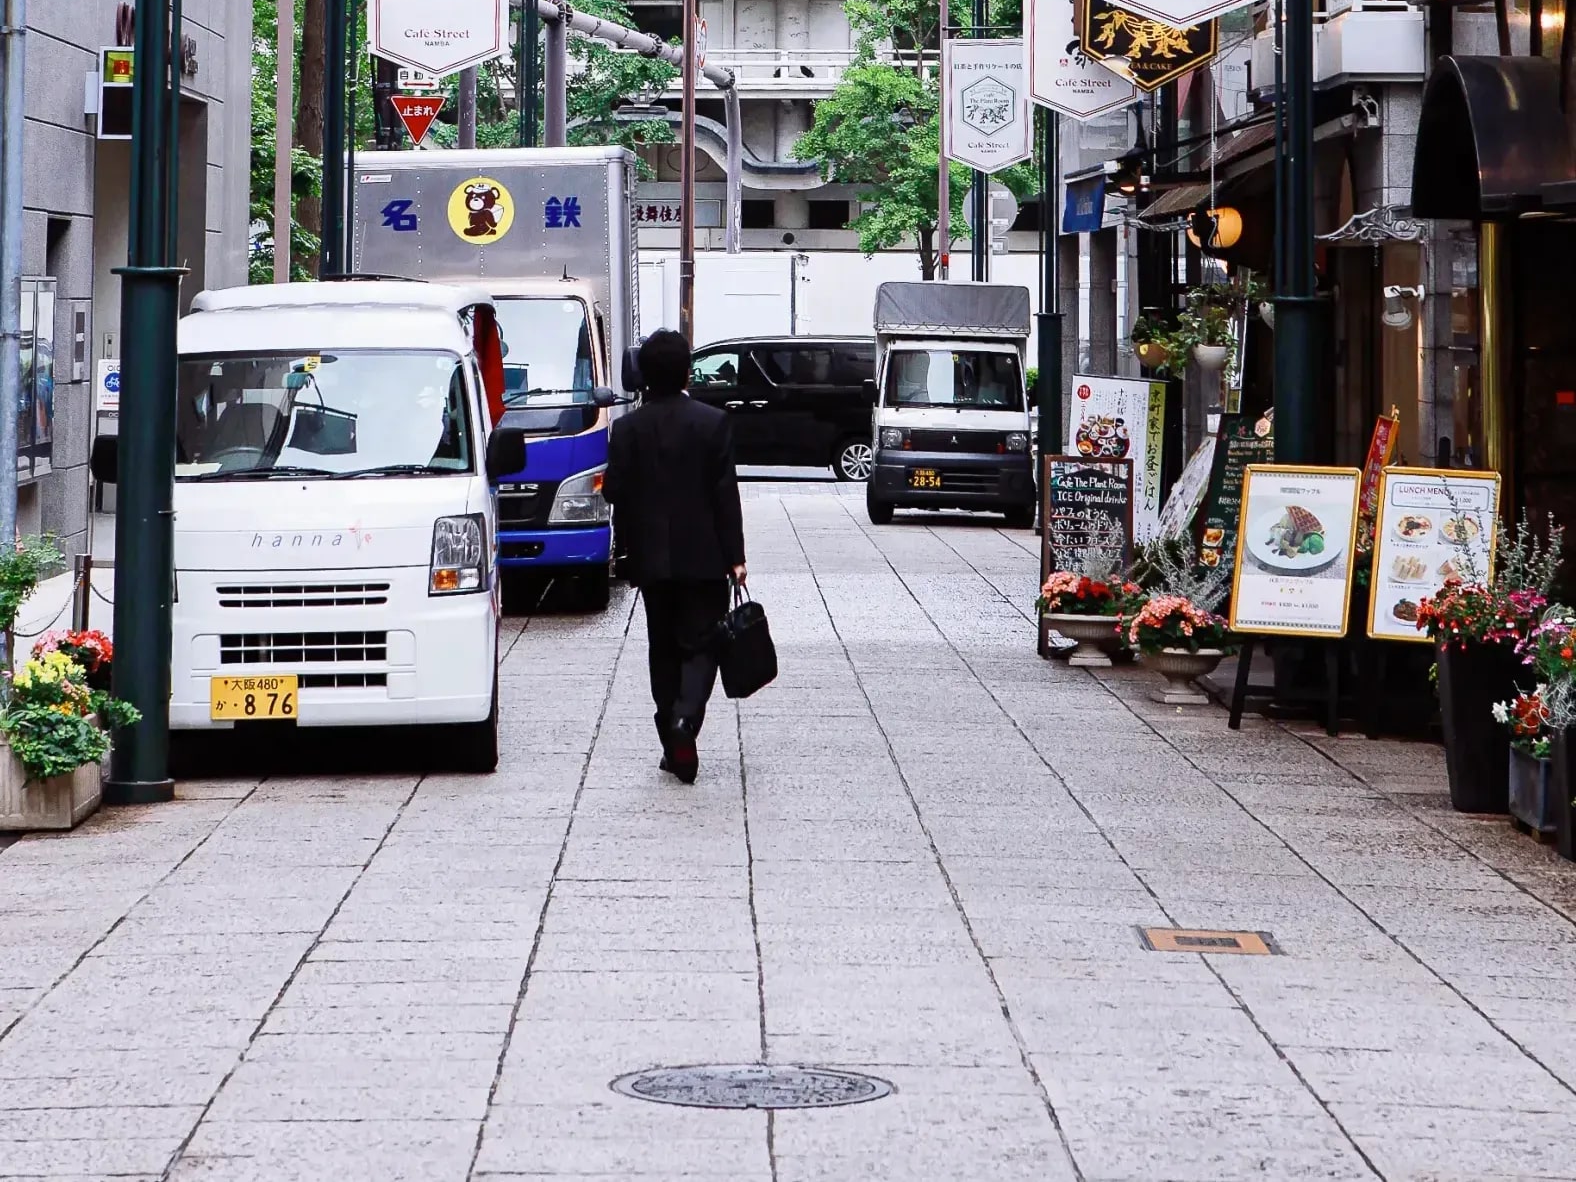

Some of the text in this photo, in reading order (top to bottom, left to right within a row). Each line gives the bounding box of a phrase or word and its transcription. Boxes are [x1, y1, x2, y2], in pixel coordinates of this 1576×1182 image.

[404, 28, 470, 39] Café Street
[400, 71, 434, 80] 自動
[1055, 77, 1112, 88] Café Street
[402, 105, 435, 117] 止まれ
[380, 196, 582, 231] 名 鉄
[1075, 477, 1088, 488] The
[1089, 476, 1107, 488] Plant
[1108, 478, 1127, 489] Room
[1399, 486, 1426, 494] LUNCH
[1057, 491, 1073, 502] ICE
[1074, 491, 1104, 505] Original
[251, 533, 343, 548] hanna
[231, 678, 279, 690] 大阪480
